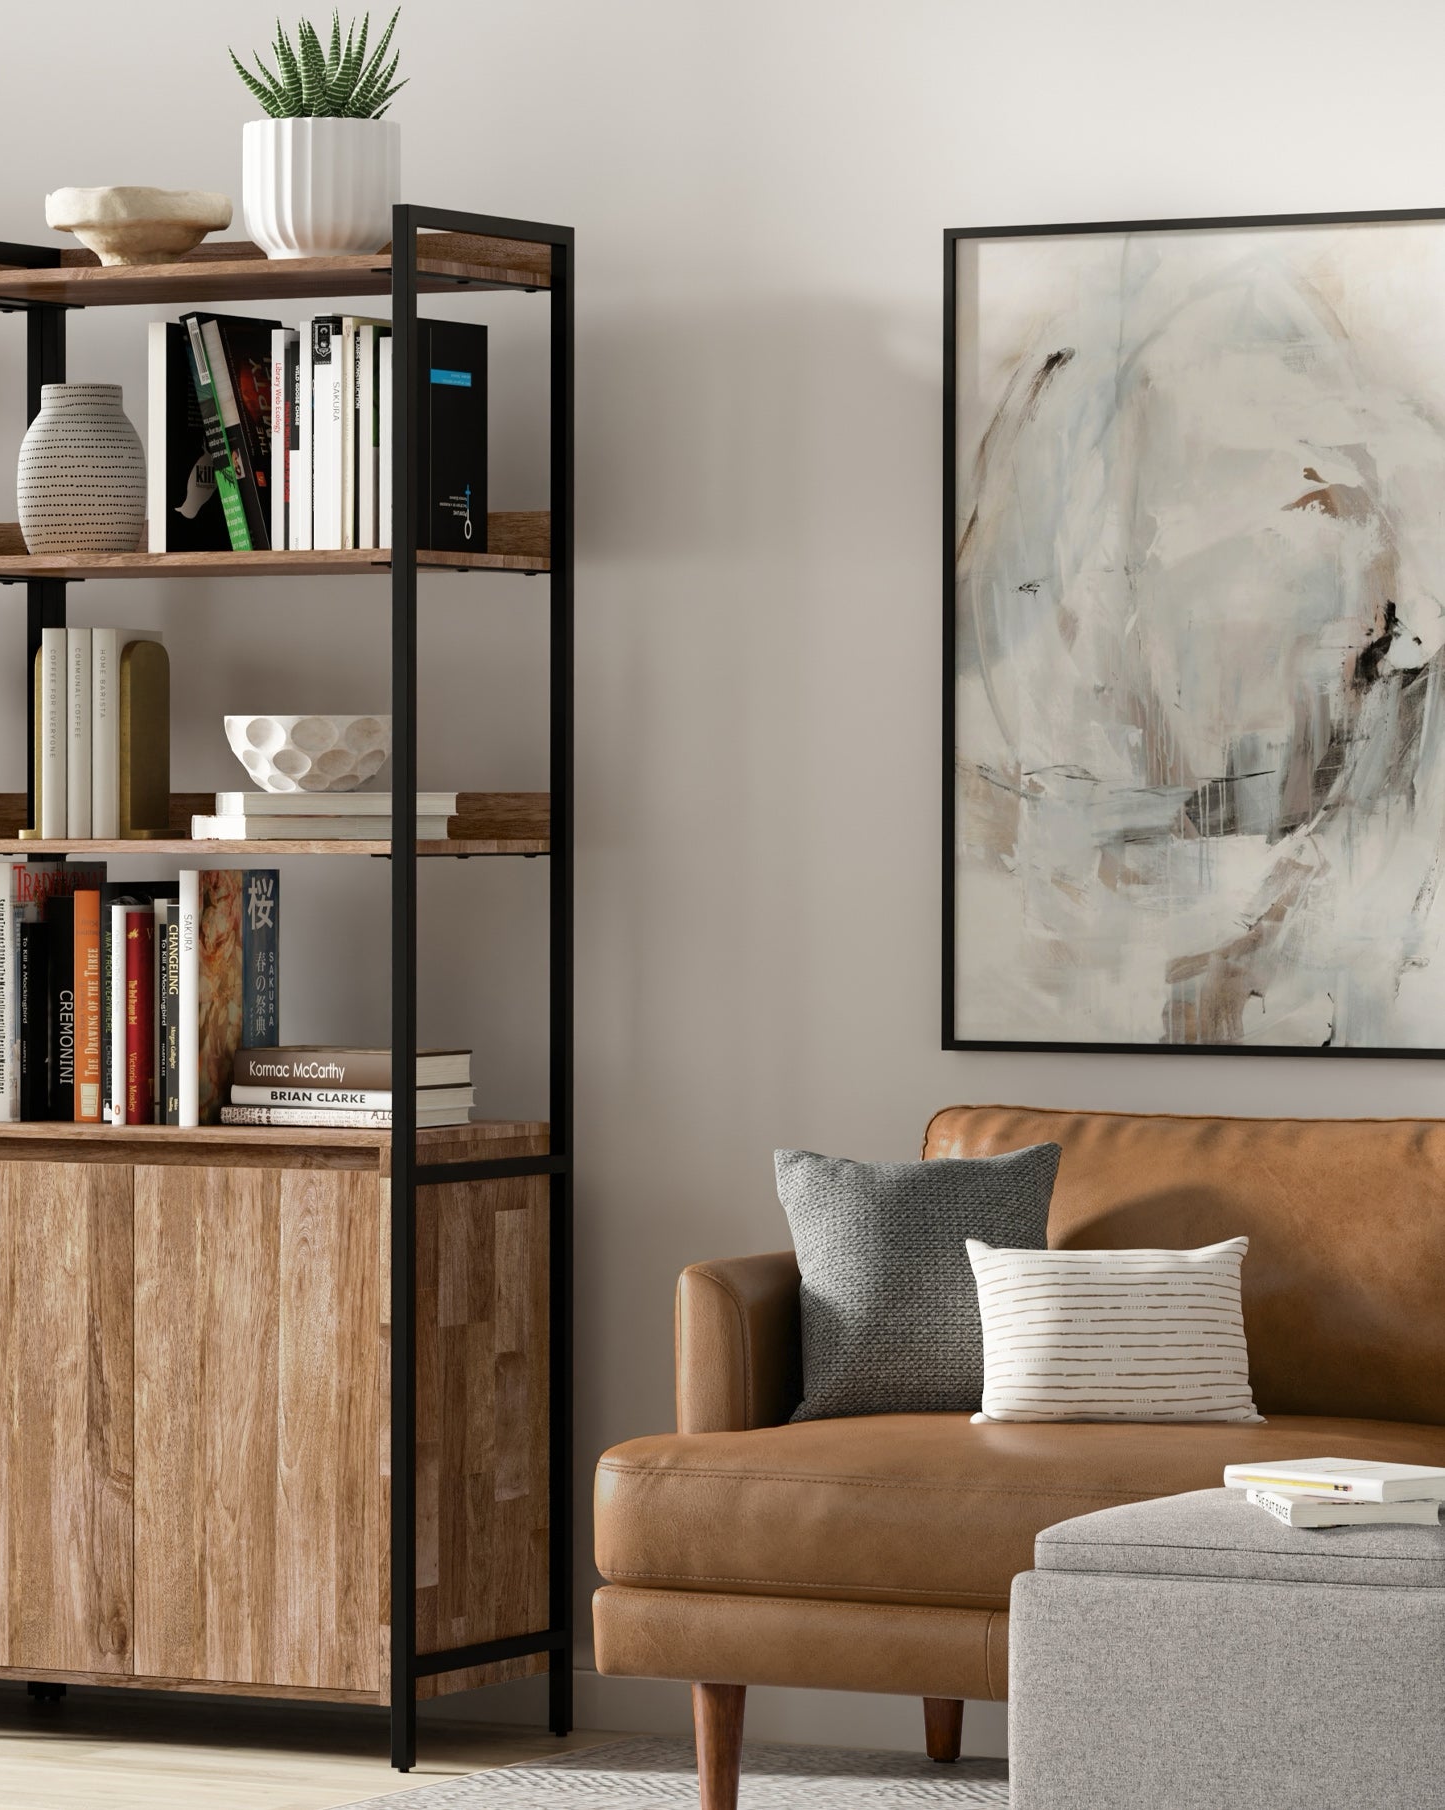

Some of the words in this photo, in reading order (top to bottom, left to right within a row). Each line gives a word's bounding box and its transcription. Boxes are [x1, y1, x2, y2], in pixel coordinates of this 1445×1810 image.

[273, 362, 282, 387] Library
[273, 388, 282, 405] Web
[273, 406, 282, 434] Ecology
[257, 426, 268, 455] THE
[249, 877, 273, 930] 桜
[22, 937, 28, 947] To
[161, 938, 167, 950] To
[184, 914, 193, 952] SAKURA
[84, 948, 99, 976] THREE
[169, 924, 179, 995] CHANGELING
[87, 980, 99, 996] THE
[87, 1000, 99, 1012] OF
[59, 990, 73, 1084] CREMONINI
[85, 1014, 99, 1054] DRAWING
[85, 1058, 99, 1076] THE
[129, 1052, 137, 1082] Victoria
[249, 1060, 289, 1078] Kormac
[293, 1062, 345, 1083] McCarthy
[129, 1085, 137, 1112] Mosley
[271, 1091, 312, 1102] BRIAN
[317, 1092, 366, 1104] CLARKE
